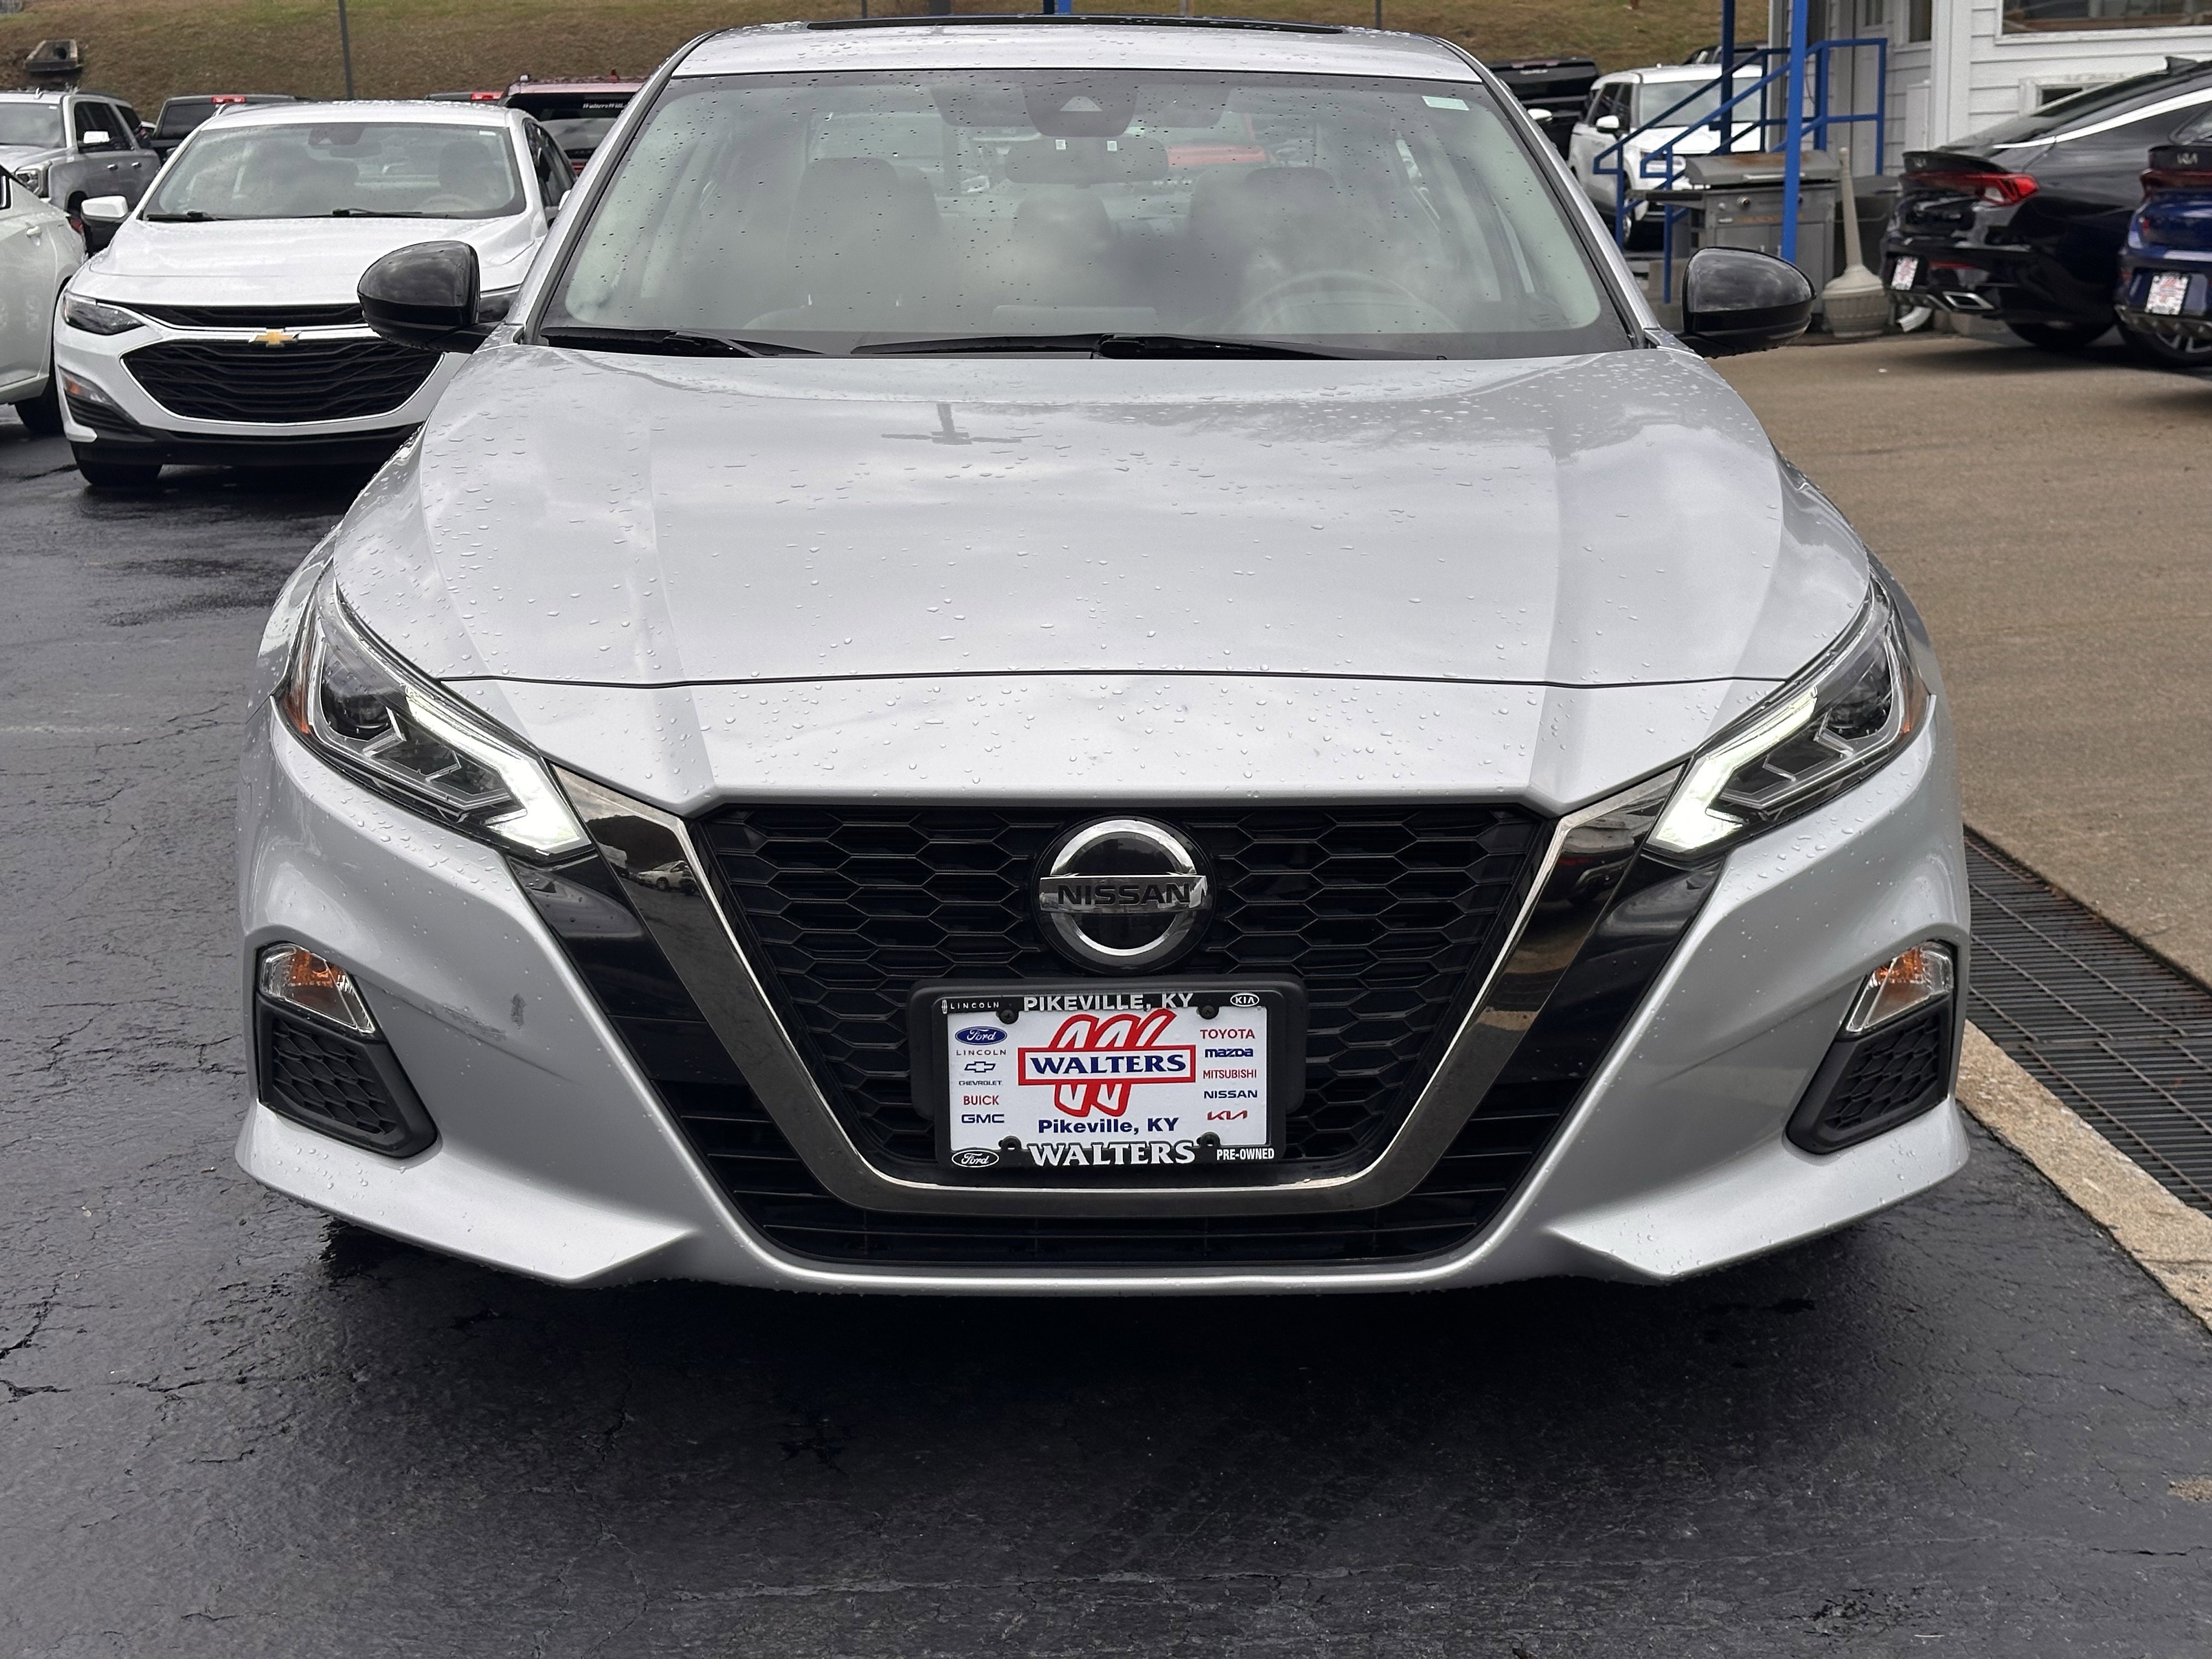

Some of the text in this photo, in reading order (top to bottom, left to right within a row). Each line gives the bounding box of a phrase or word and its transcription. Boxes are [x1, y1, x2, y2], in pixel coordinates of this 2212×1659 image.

[1057, 882, 1190, 906] NISSAN
[950, 1001, 999, 1009] LINCOLN
[1024, 992, 1194, 1012] PIKEVILLE, KY
[966, 1028, 997, 1041] Ford
[1200, 1029, 1256, 1039] TOYOTA
[1205, 1048, 1254, 1058] mazda
[1030, 1054, 1186, 1075] WALTERS
[1203, 1069, 1257, 1079] MITSUBISHI
[963, 1095, 999, 1105] BUICK
[1204, 1090, 1257, 1099] NISSAN
[961, 1114, 1005, 1124] GMC
[1038, 1118, 1179, 1135] Pikeville, KY
[961, 1153, 990, 1165] Ford
[1028, 1142, 1195, 1166] WALTERS
[1216, 1148, 1275, 1160] PRE-OWNED
